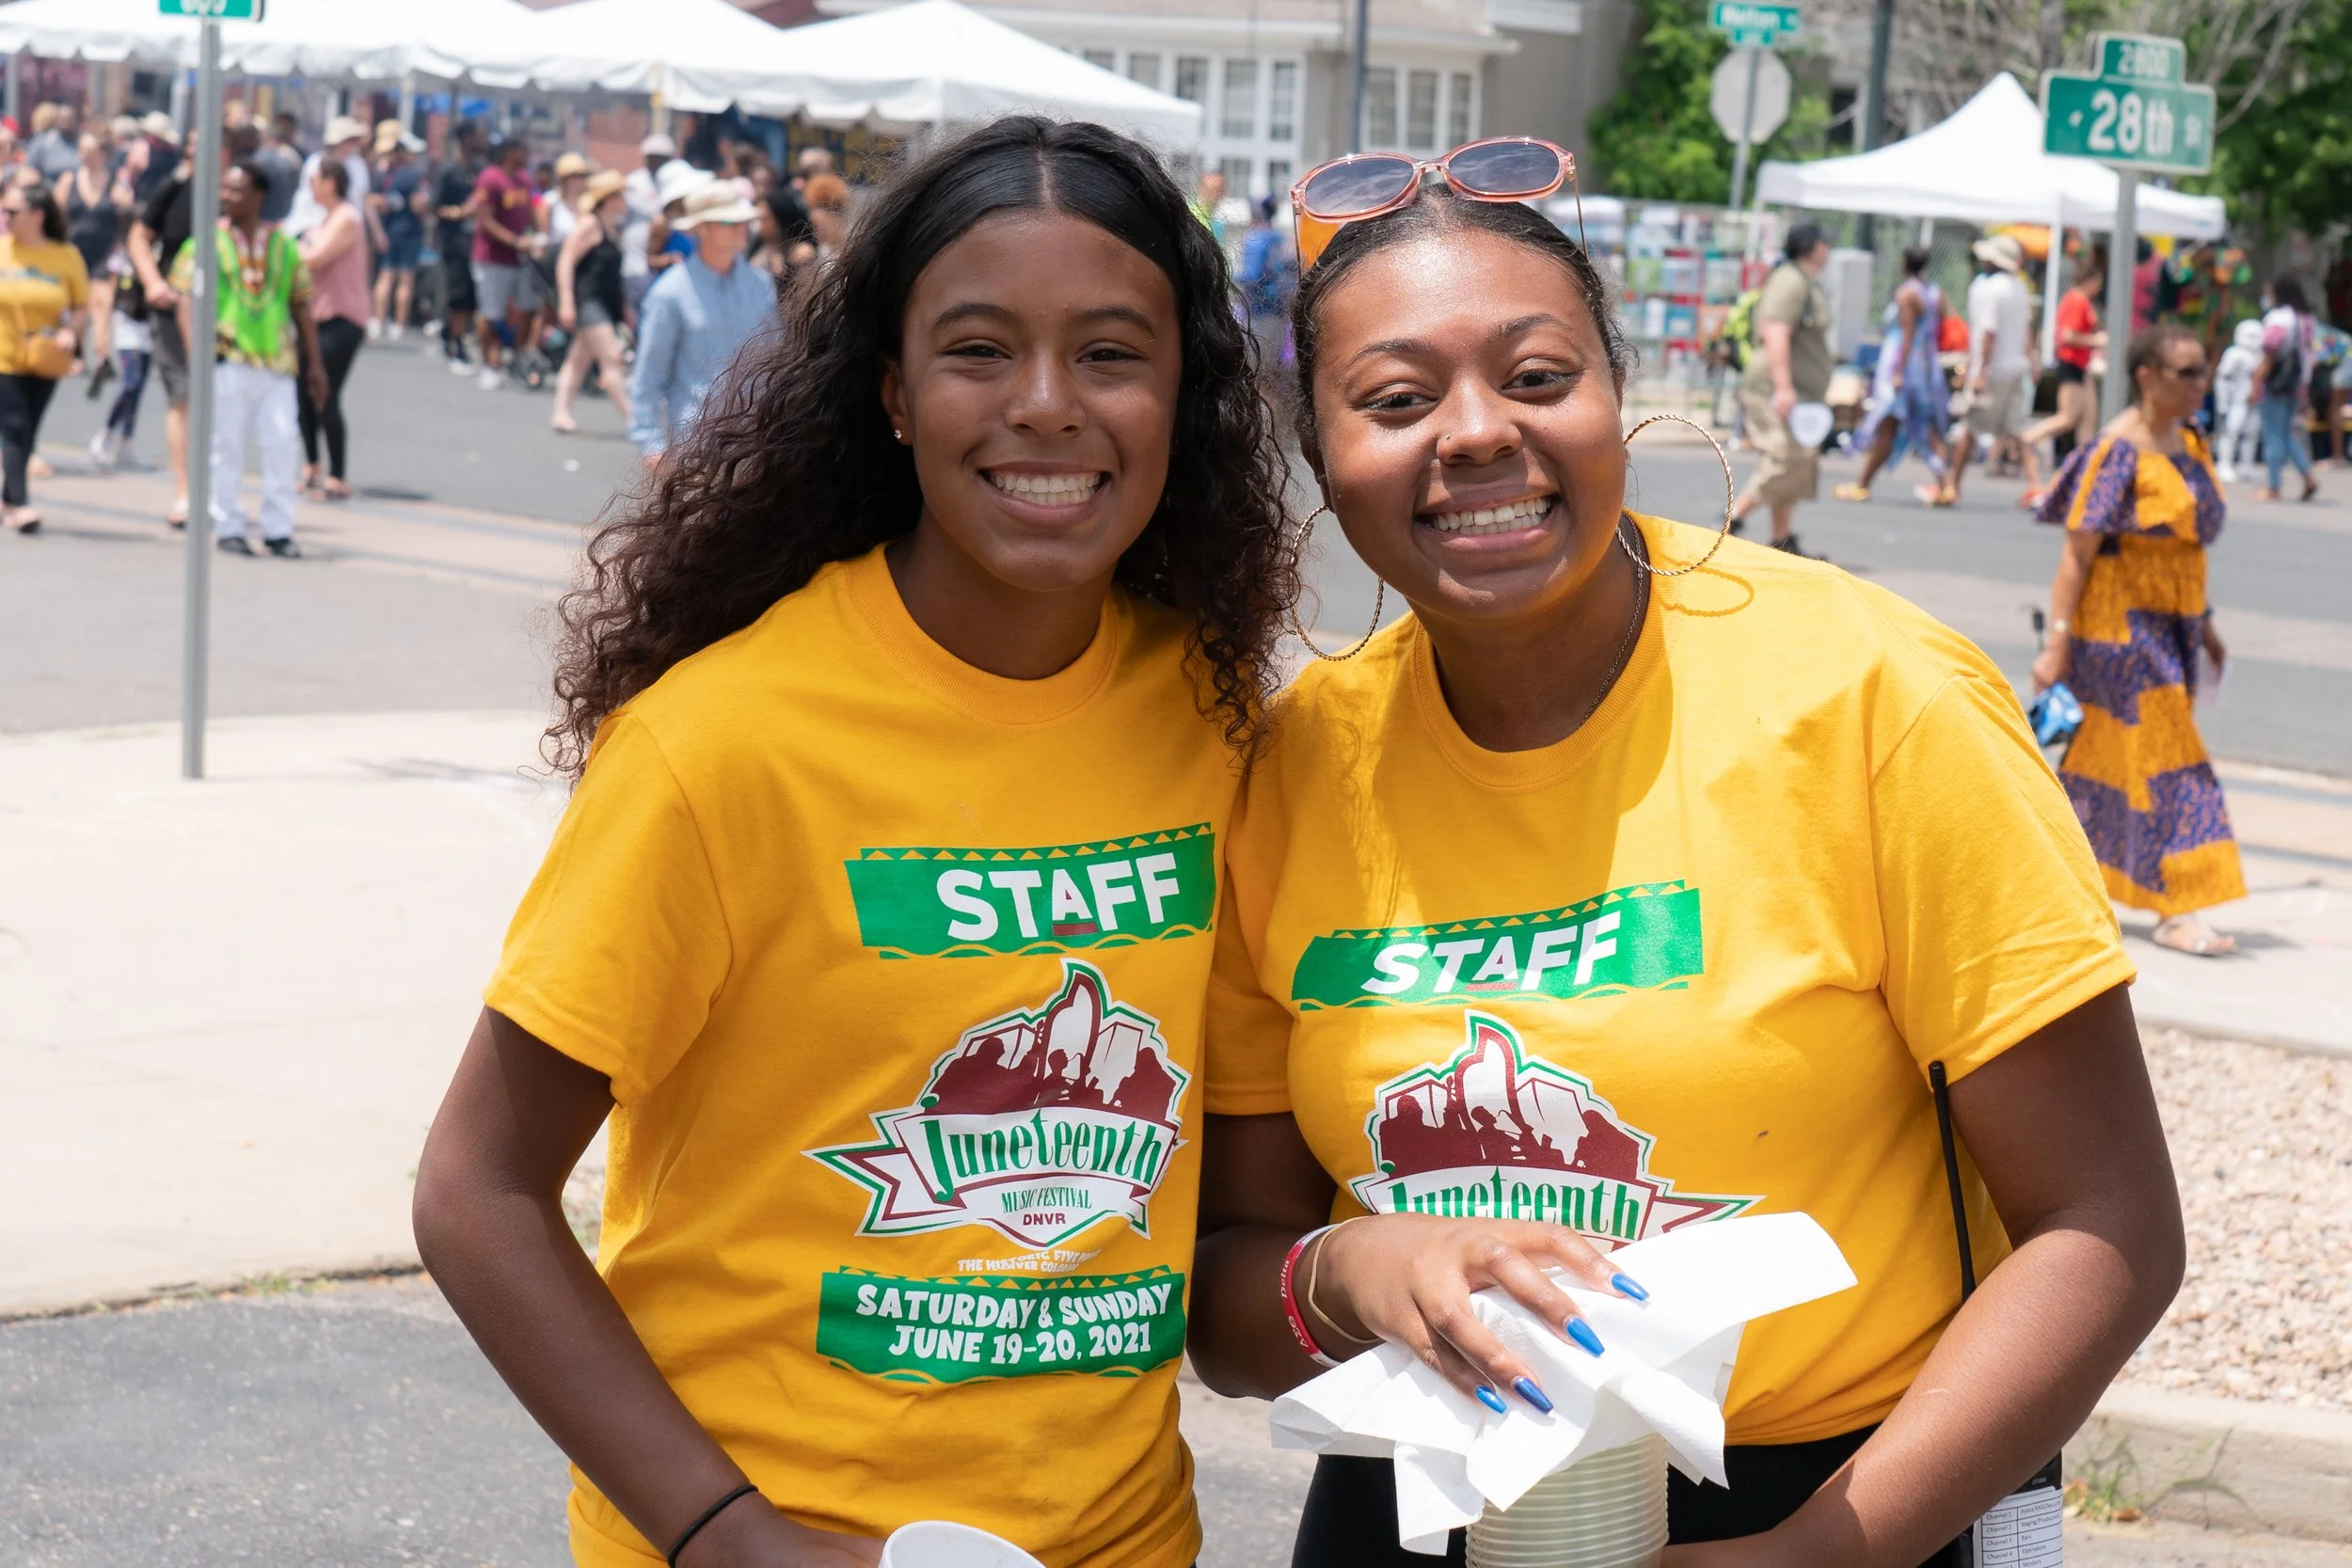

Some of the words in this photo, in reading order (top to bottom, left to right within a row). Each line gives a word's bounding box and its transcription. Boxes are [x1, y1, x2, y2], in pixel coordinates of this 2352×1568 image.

[2118, 42, 2169, 78] 2800
[2087, 87, 2174, 155] 28th
[936, 852, 1180, 942] STAFF
[1359, 910, 1621, 994] STAFF
[919, 1093, 1166, 1202] Juneteenth
[1001, 1188, 1038, 1213] MUSIC
[1037, 1186, 1092, 1210] FESTIVAL
[1023, 1212, 1067, 1226] DNVR
[957, 1258, 983, 1272] THE
[1053, 1249, 1080, 1263] FIVE
[1280, 1259, 1290, 1299] Delta
[855, 1283, 1038, 1330] SATURDAY
[1038, 1297, 1054, 1327] &
[1060, 1283, 1172, 1325] SUNDAY
[889, 1325, 984, 1363] JUNE
[990, 1328, 1083, 1365] 19-20,
[1088, 1321, 1152, 1358] 2021
[1986, 1513, 2008, 1521] Channel
[1986, 1526, 2008, 1534] Channel
[1986, 1538, 2009, 1547] Channel
[1986, 1551, 2010, 1560] Channel
[2022, 1544, 2047, 1556] Operations
[2022, 1558, 2042, 1568] Vendors
